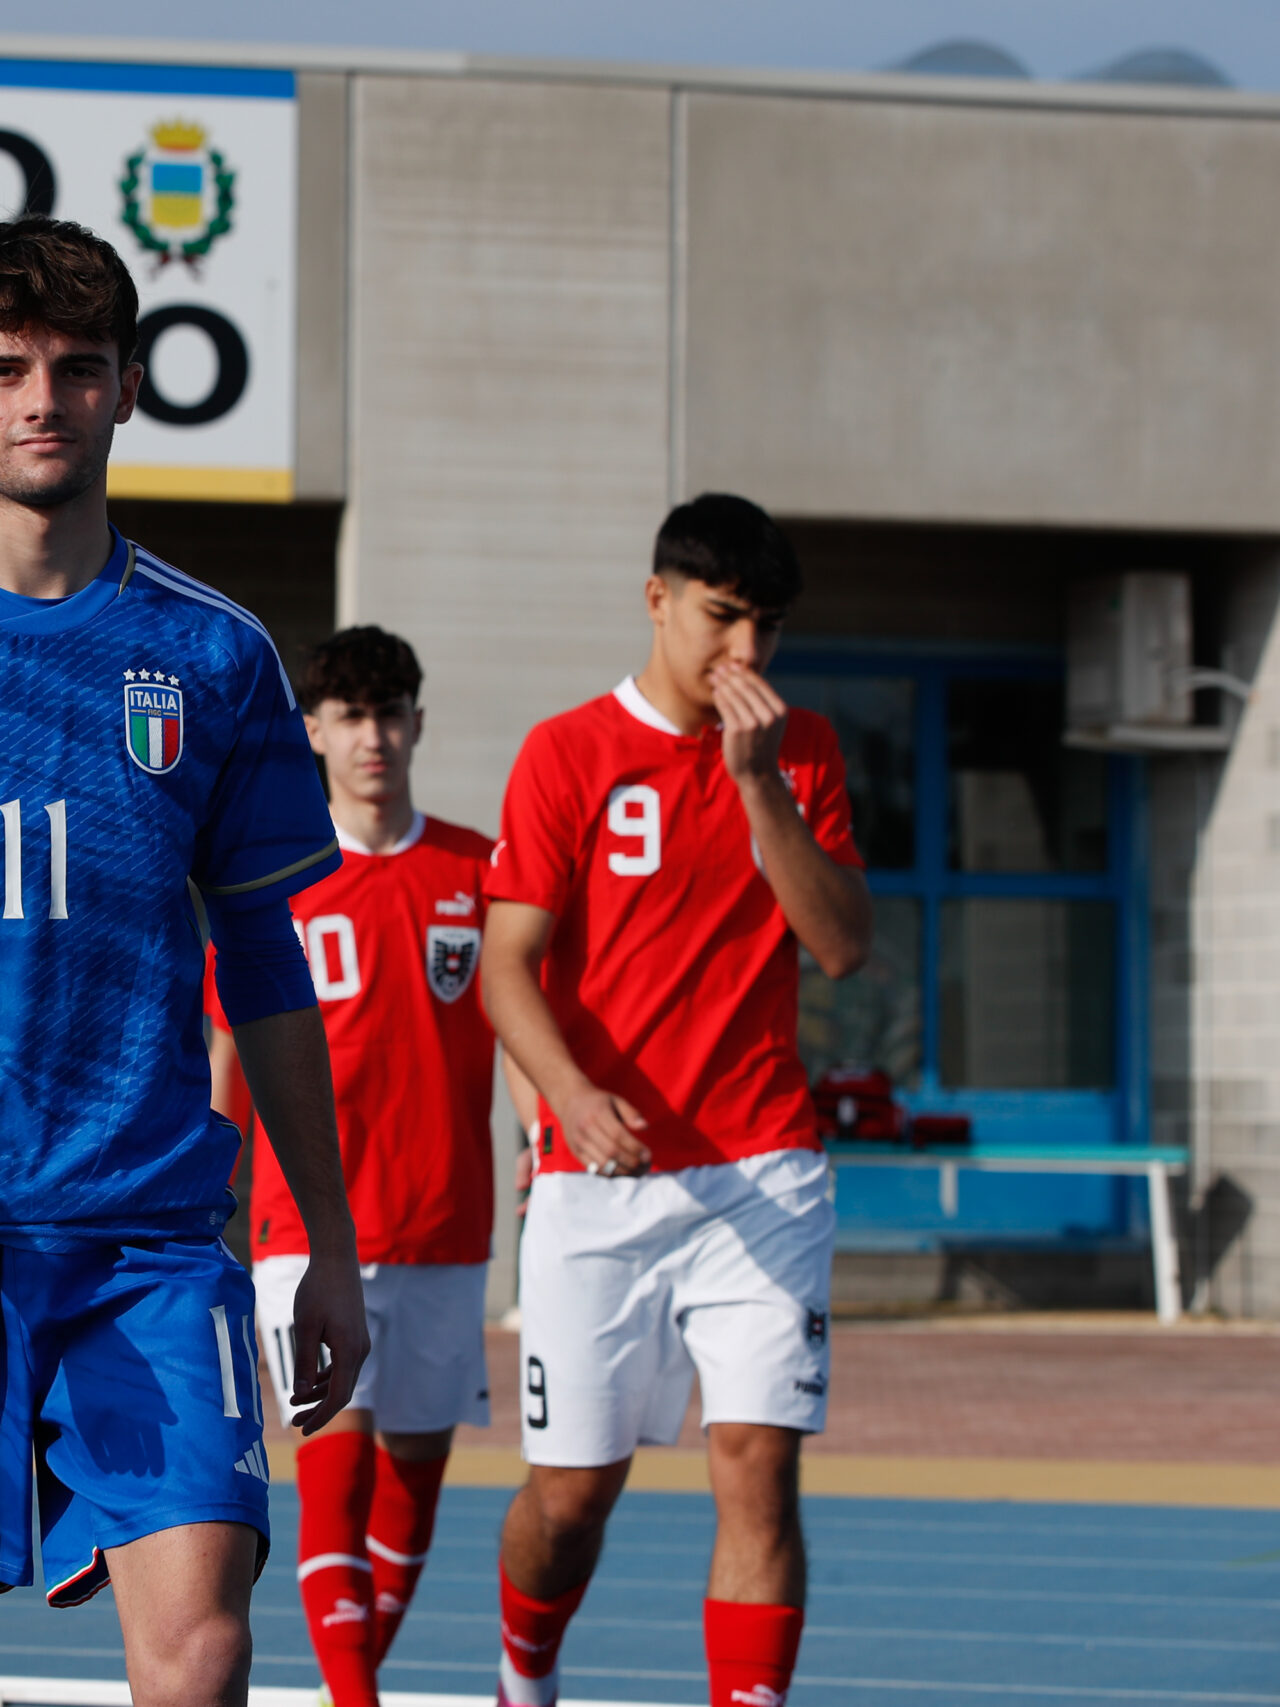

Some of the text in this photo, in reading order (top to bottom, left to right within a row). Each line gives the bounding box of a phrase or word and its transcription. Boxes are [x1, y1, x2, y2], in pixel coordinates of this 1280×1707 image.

[130, 690, 178, 710] ITALIA
[607, 784, 661, 876] 9
[292, 912, 361, 1002] 0
[208, 1304, 263, 1427] 11
[527, 1355, 548, 1430] 9
